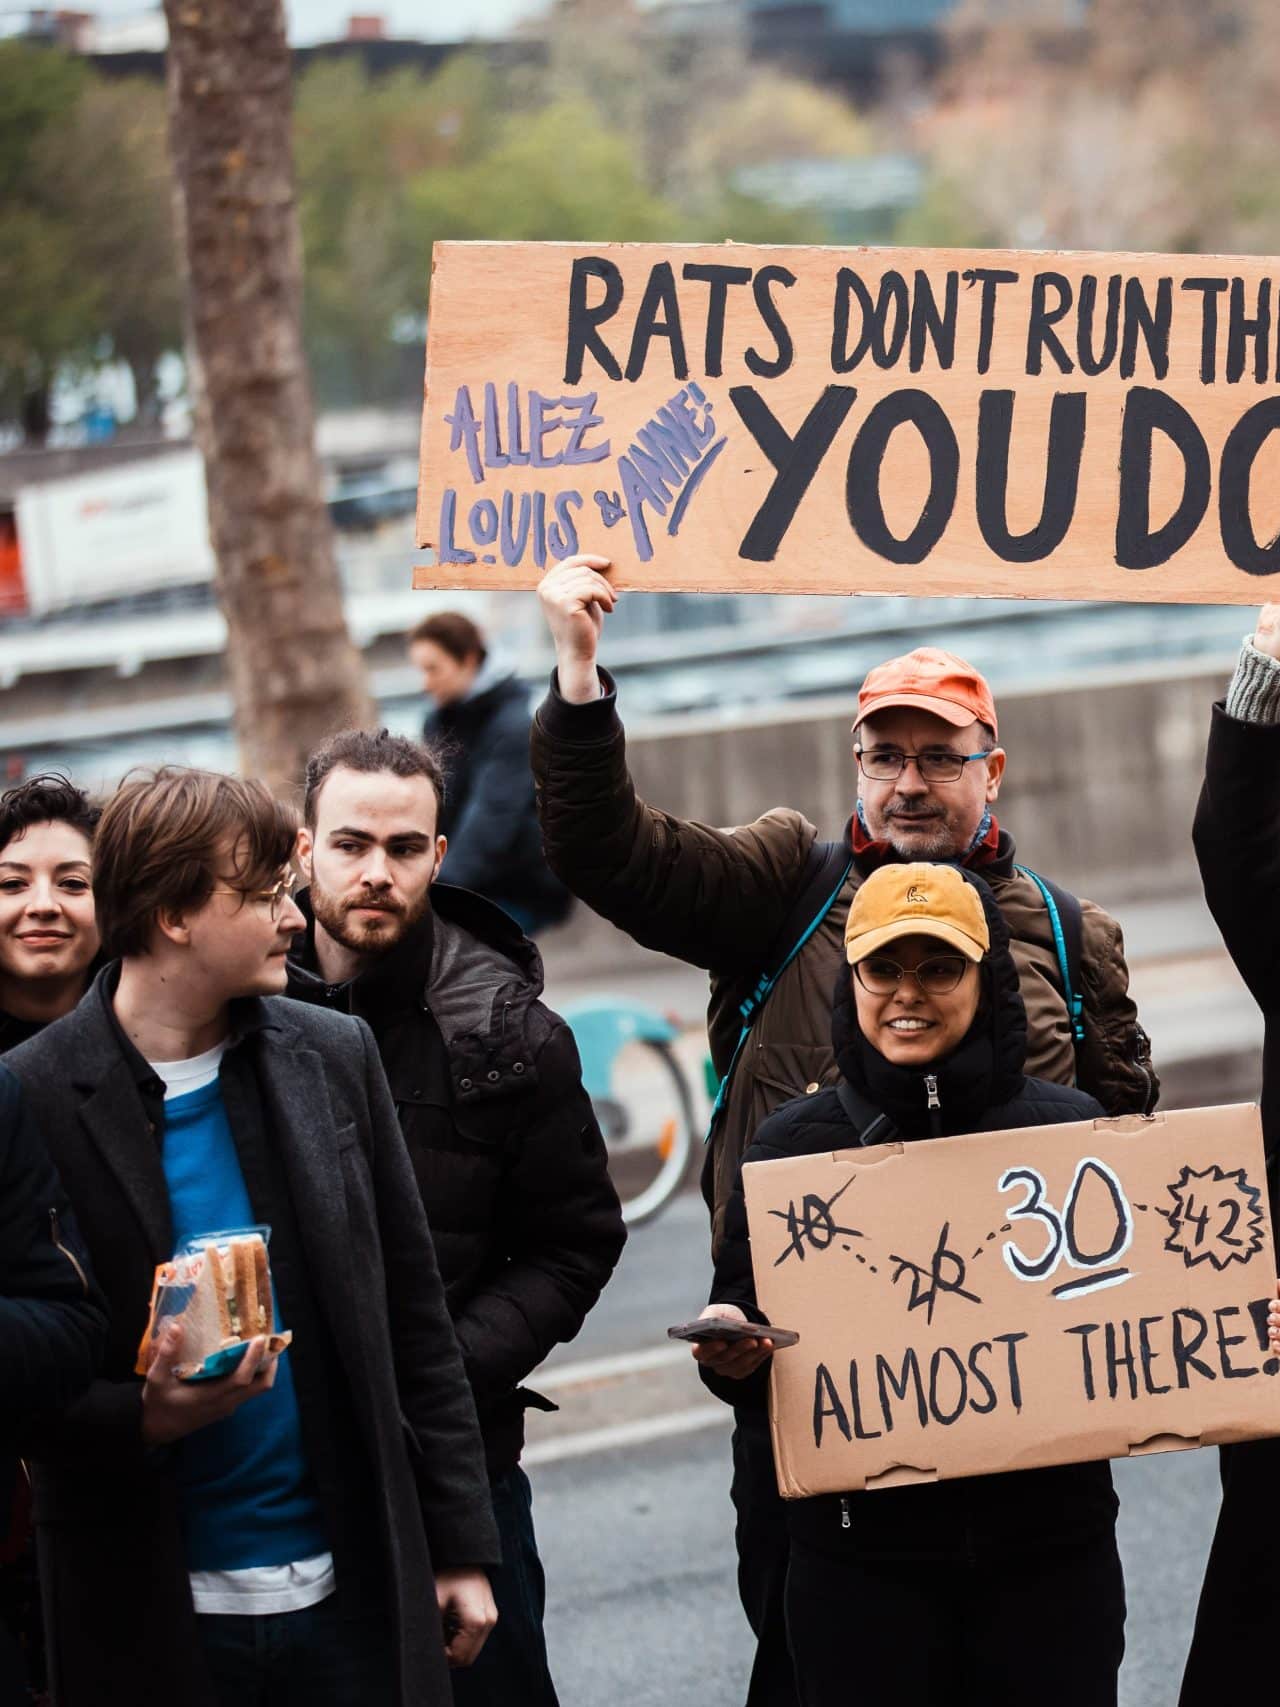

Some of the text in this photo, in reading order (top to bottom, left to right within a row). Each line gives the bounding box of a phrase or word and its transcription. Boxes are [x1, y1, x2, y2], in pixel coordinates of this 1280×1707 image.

[563, 256, 797, 385] RATS
[830, 266, 1019, 375] DON'T
[1026, 271, 1173, 380] RUN
[444, 382, 611, 484] ALLEZ
[729, 385, 1087, 565] YOU
[439, 489, 582, 568] LOUIS
[998, 1157, 1134, 1281] 30
[1184, 1194, 1243, 1246] 42
[812, 1298, 1280, 1447] ALMOST THERE!
